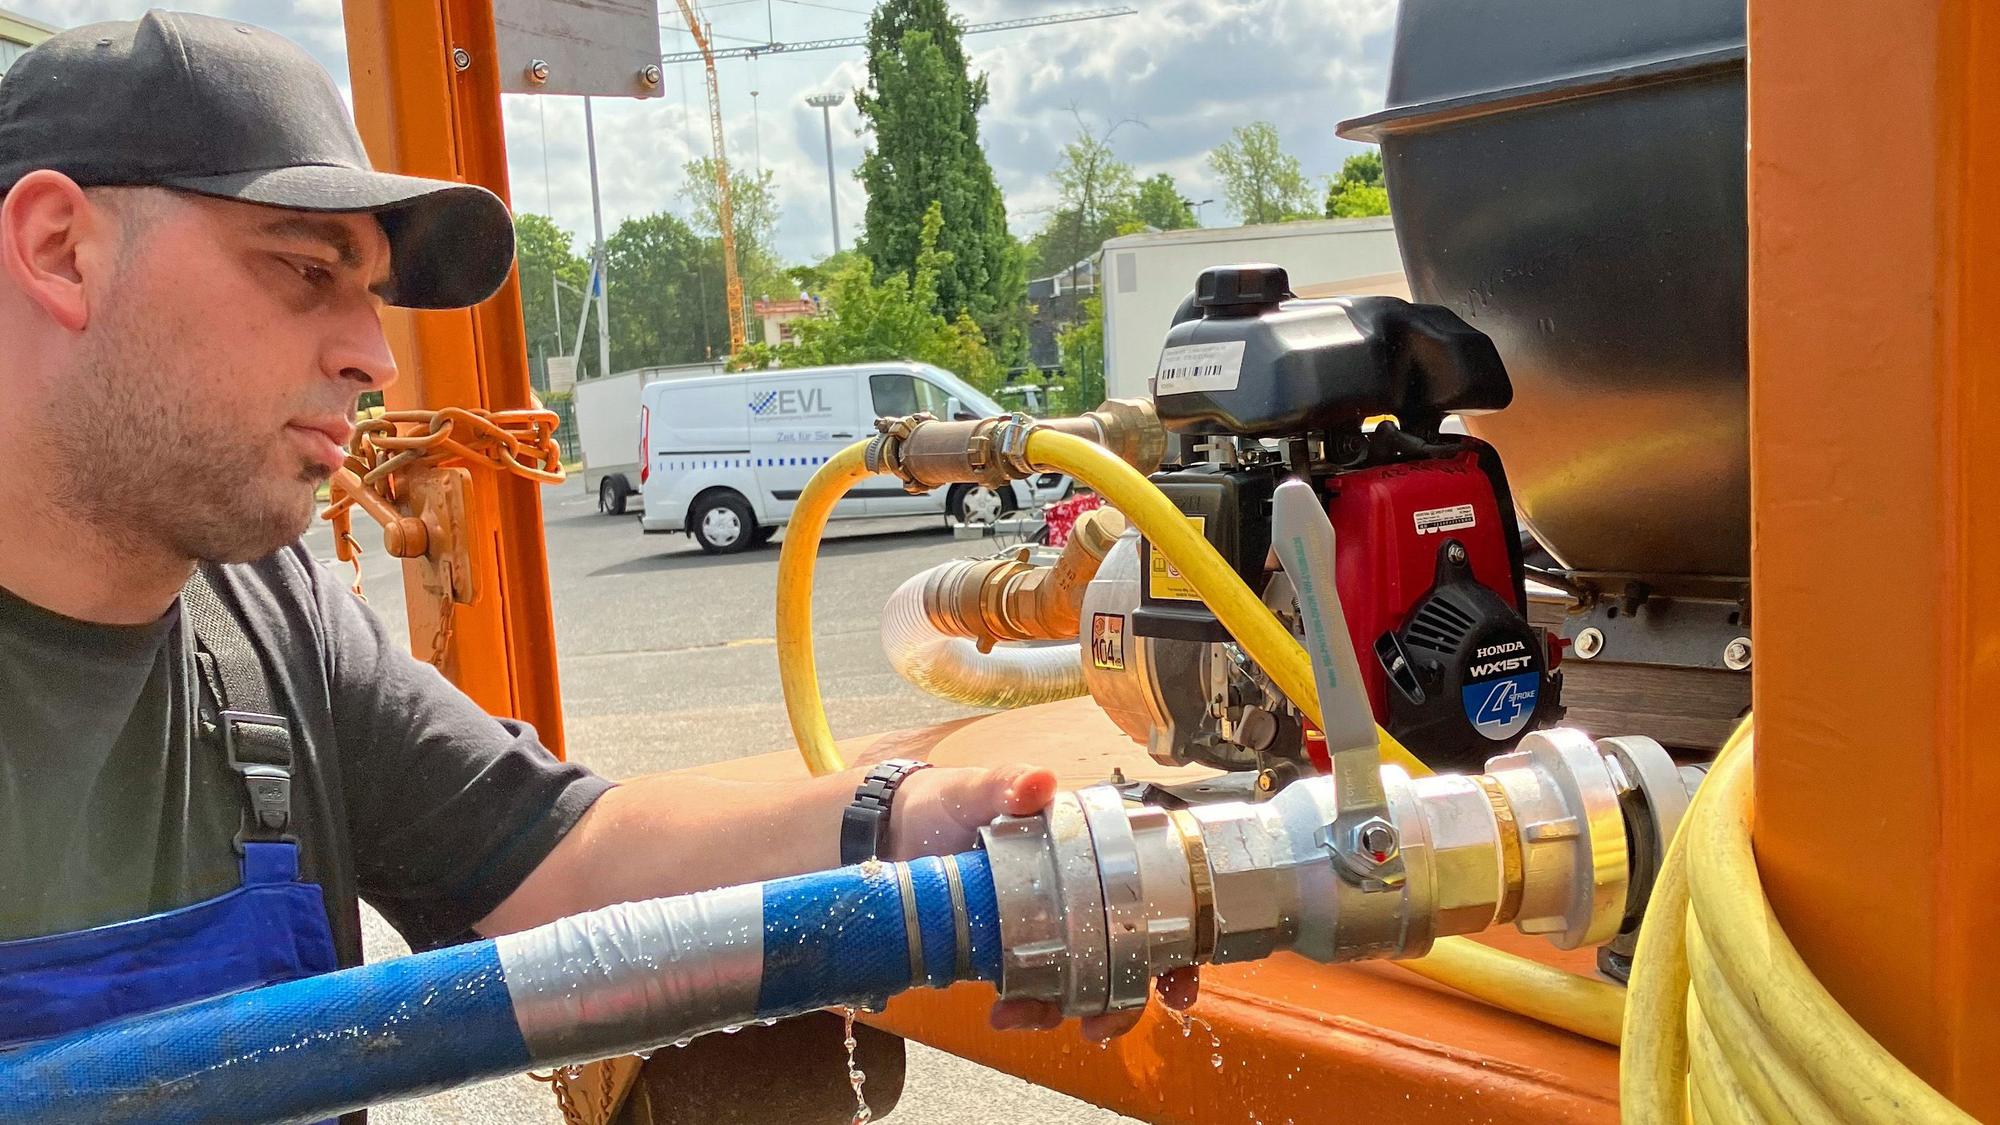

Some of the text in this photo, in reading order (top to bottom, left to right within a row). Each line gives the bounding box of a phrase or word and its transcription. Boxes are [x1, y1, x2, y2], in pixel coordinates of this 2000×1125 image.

[779, 389, 832, 414] EVL
[1093, 638, 1115, 667] 104
[1476, 641, 1525, 658] HONDA
[1470, 656, 1532, 677] WX15T
[1476, 680, 1535, 727] 4 STROKE
